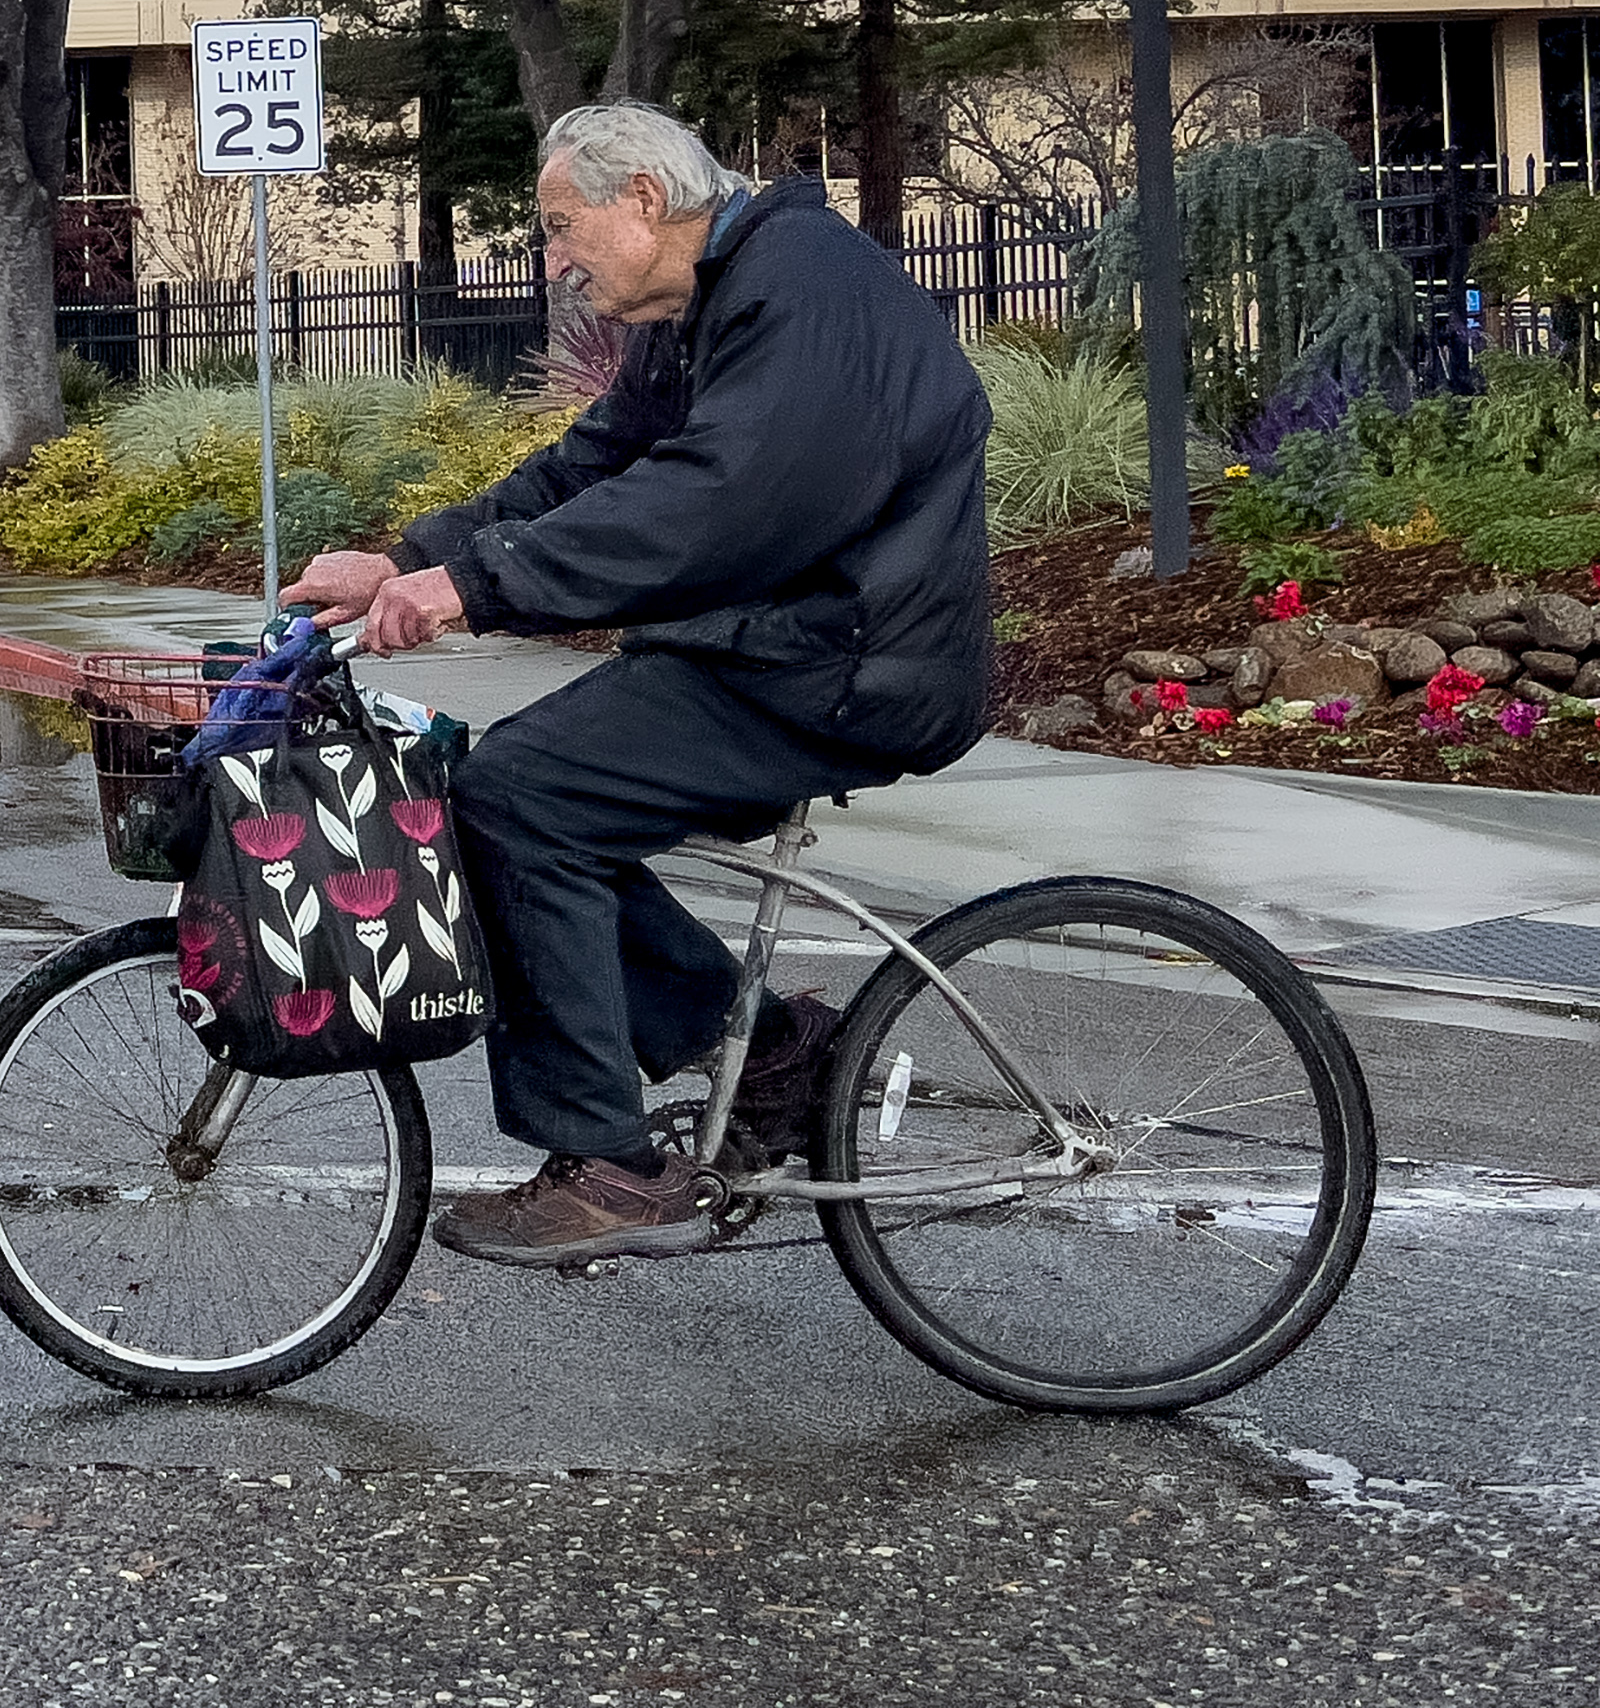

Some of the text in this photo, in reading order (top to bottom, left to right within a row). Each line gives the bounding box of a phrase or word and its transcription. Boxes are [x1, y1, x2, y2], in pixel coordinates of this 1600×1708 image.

[206, 38, 308, 62] SPEED
[218, 69, 296, 93] LIMIT
[214, 101, 304, 157] 25
[410, 987, 485, 1021] thistle
